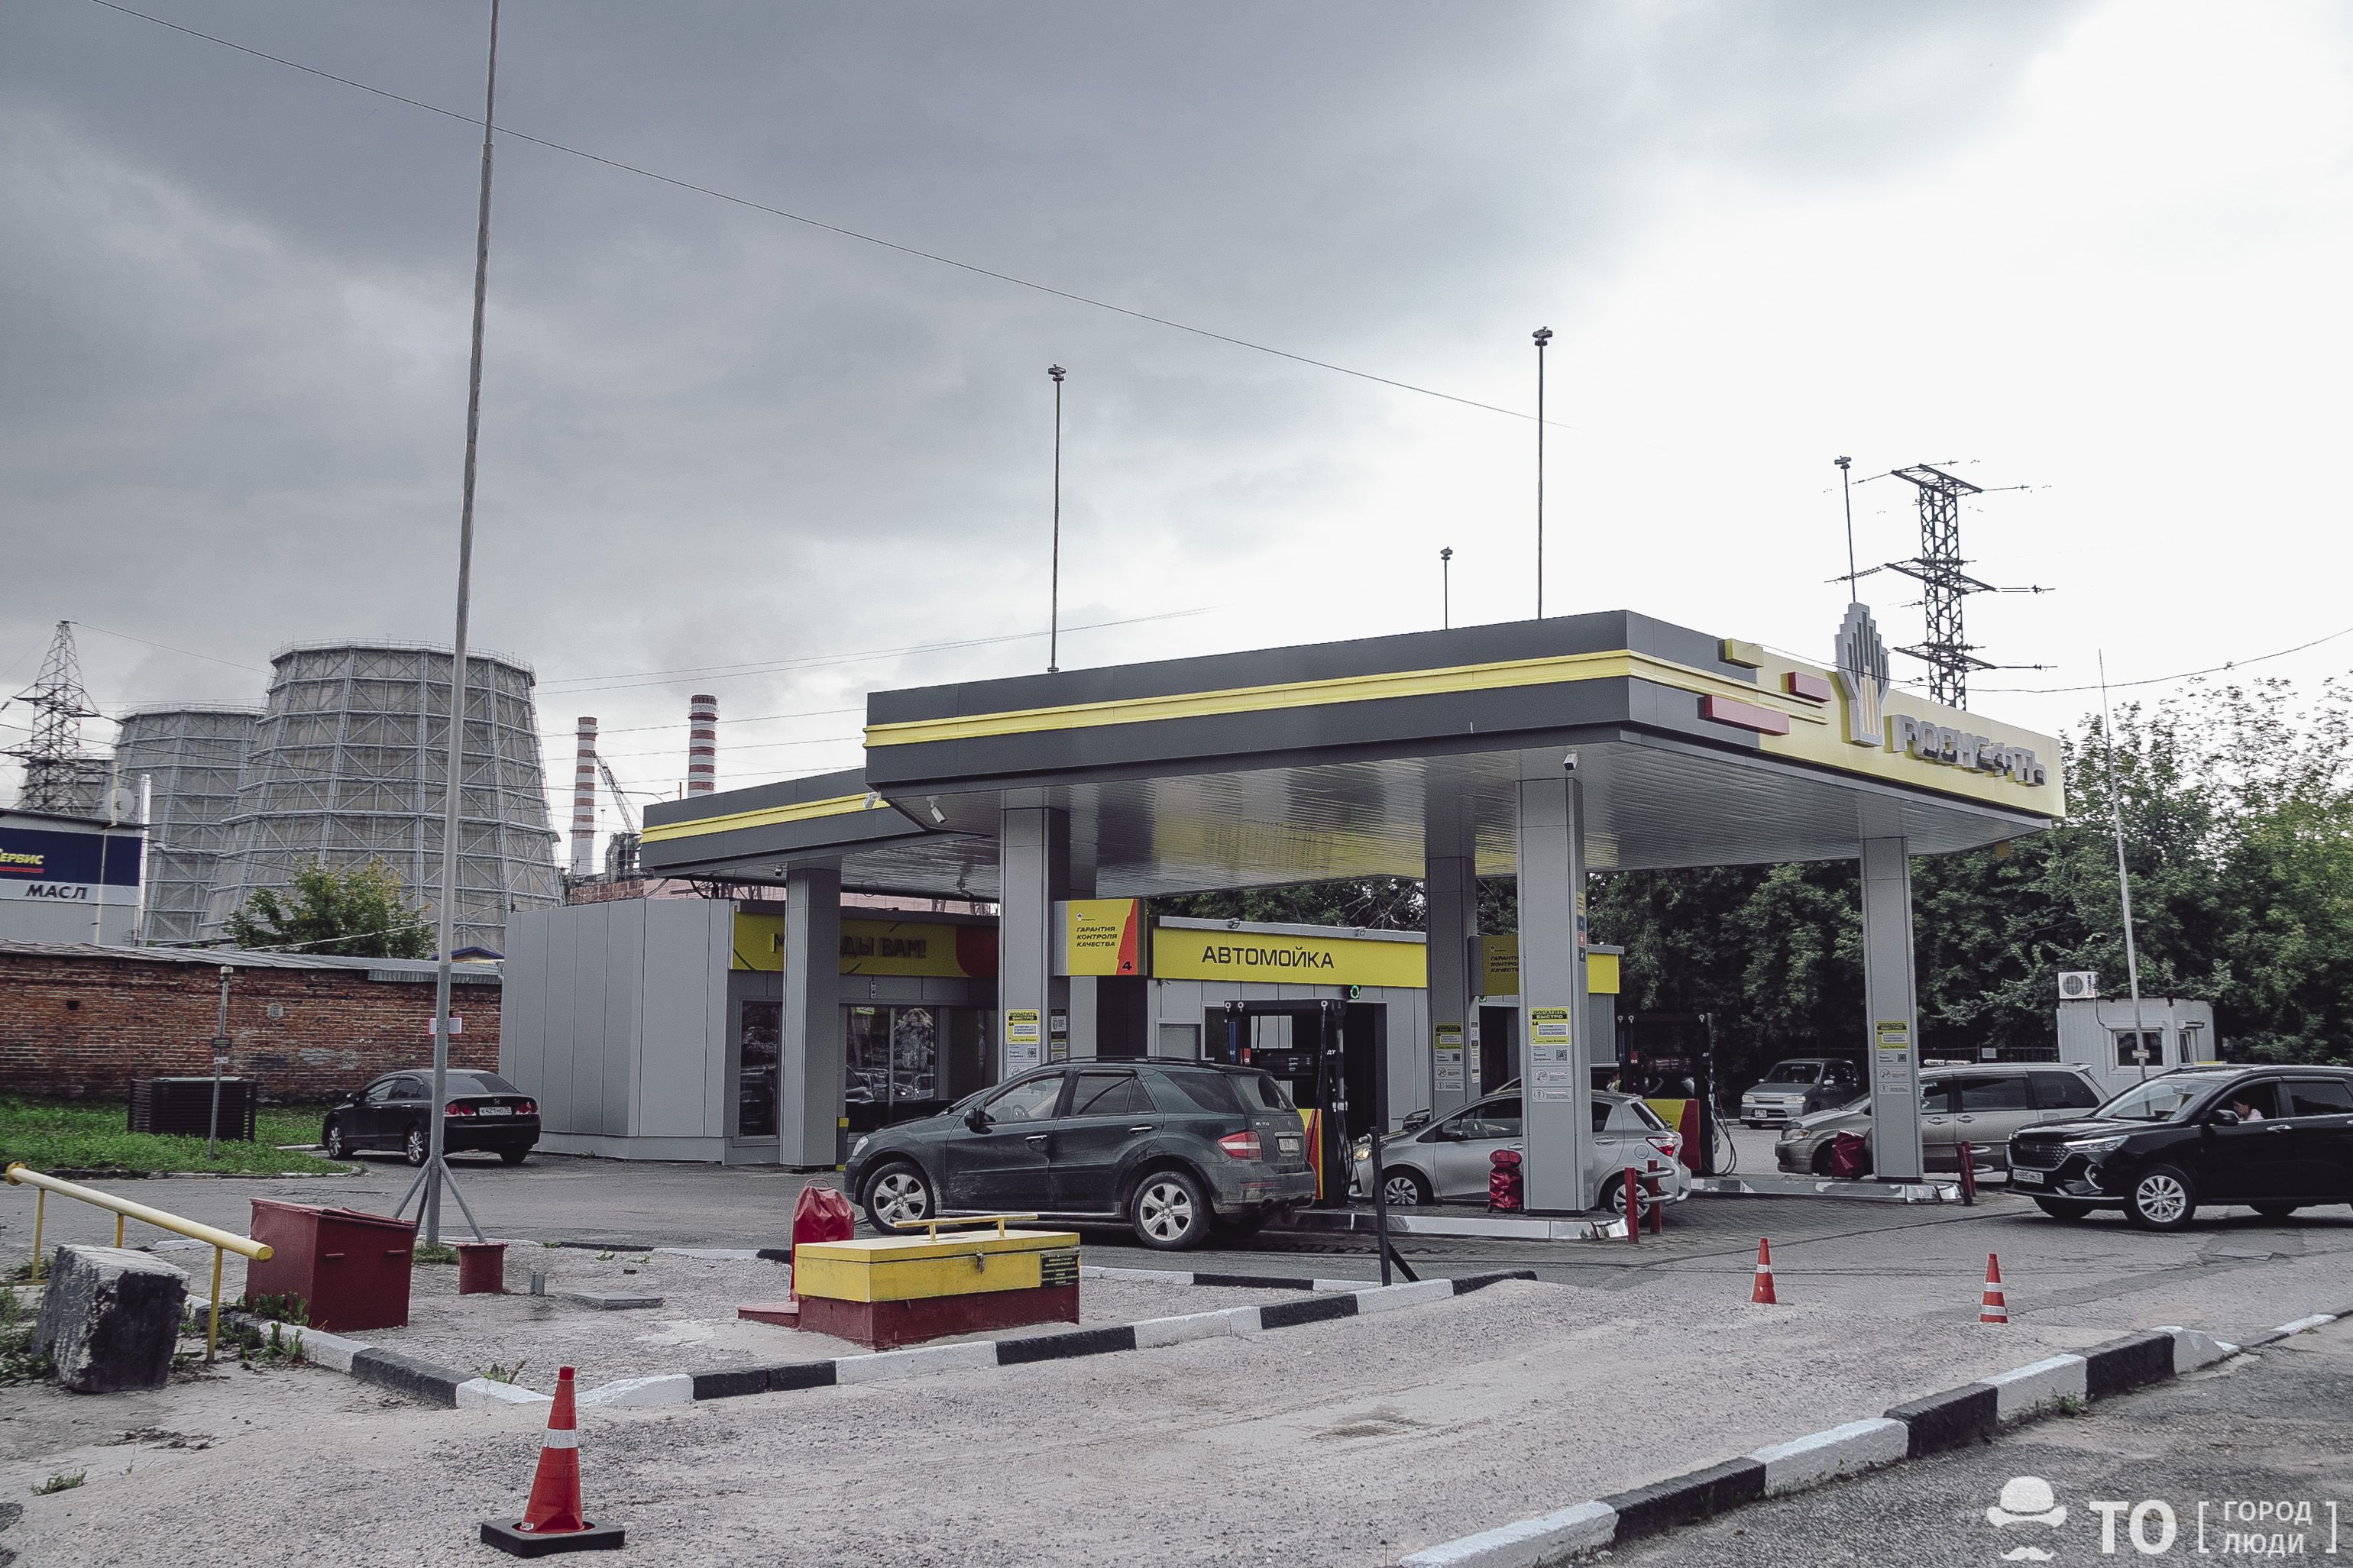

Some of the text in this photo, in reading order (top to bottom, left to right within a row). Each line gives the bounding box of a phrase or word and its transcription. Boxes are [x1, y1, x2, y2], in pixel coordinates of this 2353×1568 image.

[1884, 713, 2047, 787] РОСНЕФТЬ
[879, 937, 927, 959] ВАМ!
[1201, 945, 1335, 969] АВТОМОЙКА
[1121, 961, 1133, 971] 4
